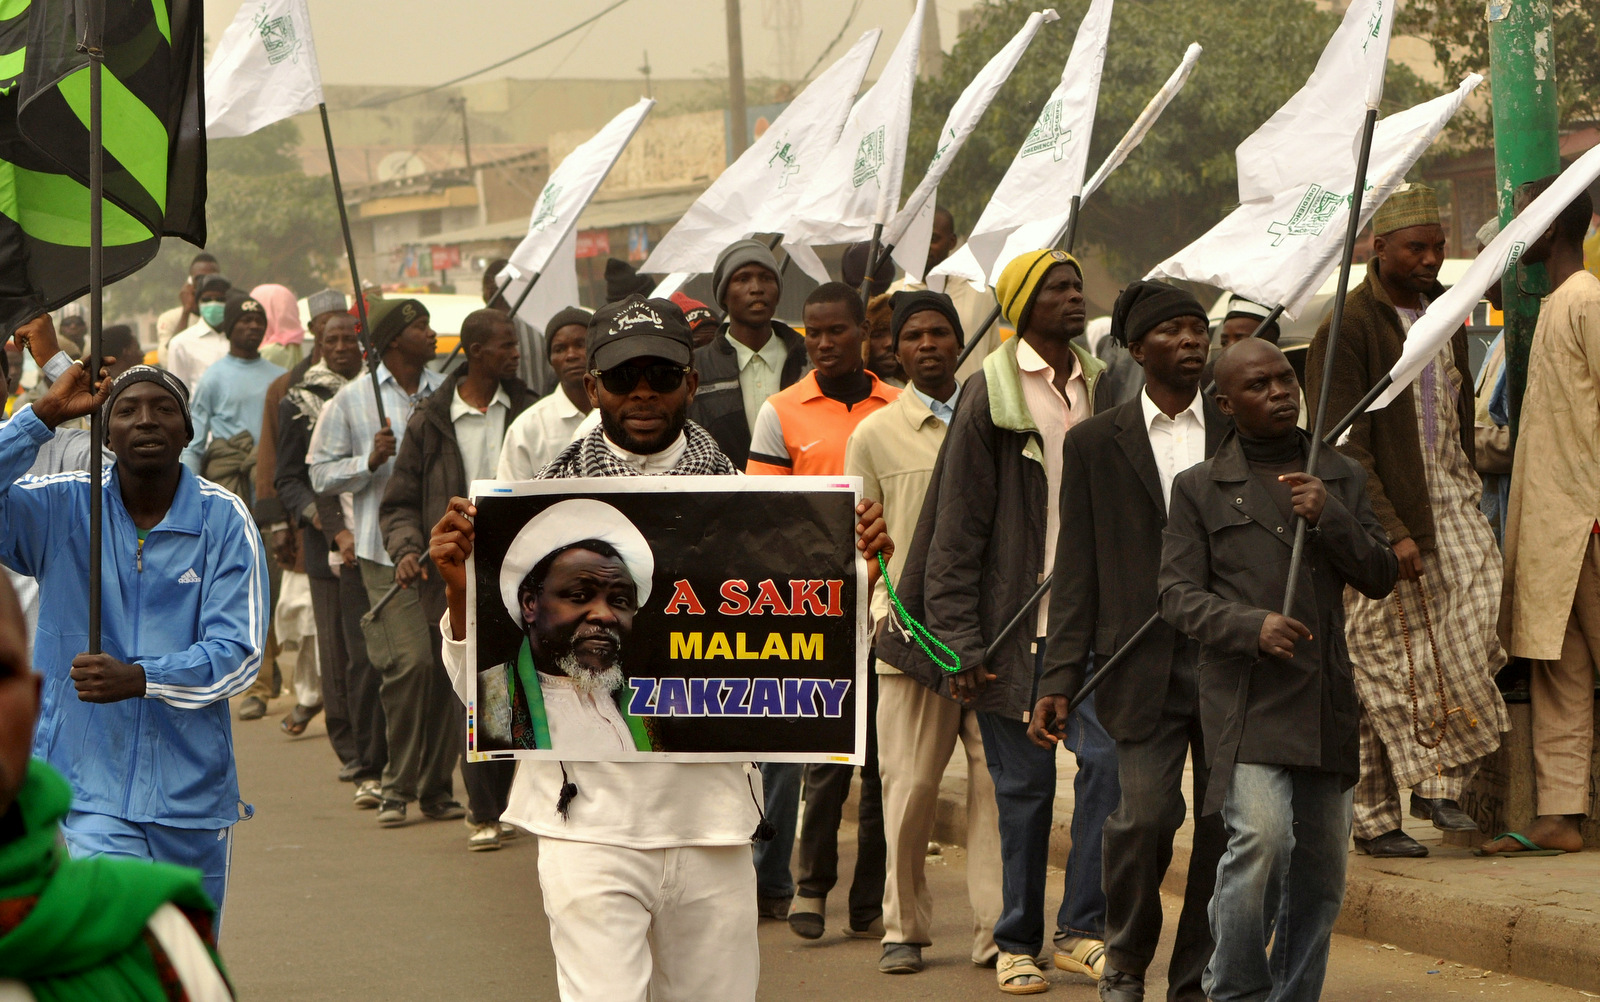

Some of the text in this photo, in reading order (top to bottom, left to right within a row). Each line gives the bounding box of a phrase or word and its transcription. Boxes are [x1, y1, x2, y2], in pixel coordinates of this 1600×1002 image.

[1024, 142, 1053, 154] OBEDIENCE
[1291, 187, 1317, 225] OBEDIENCE
[664, 579, 844, 616] A SAKI
[669, 632, 824, 661] MALAM
[628, 677, 852, 718] ZAKZAKY
